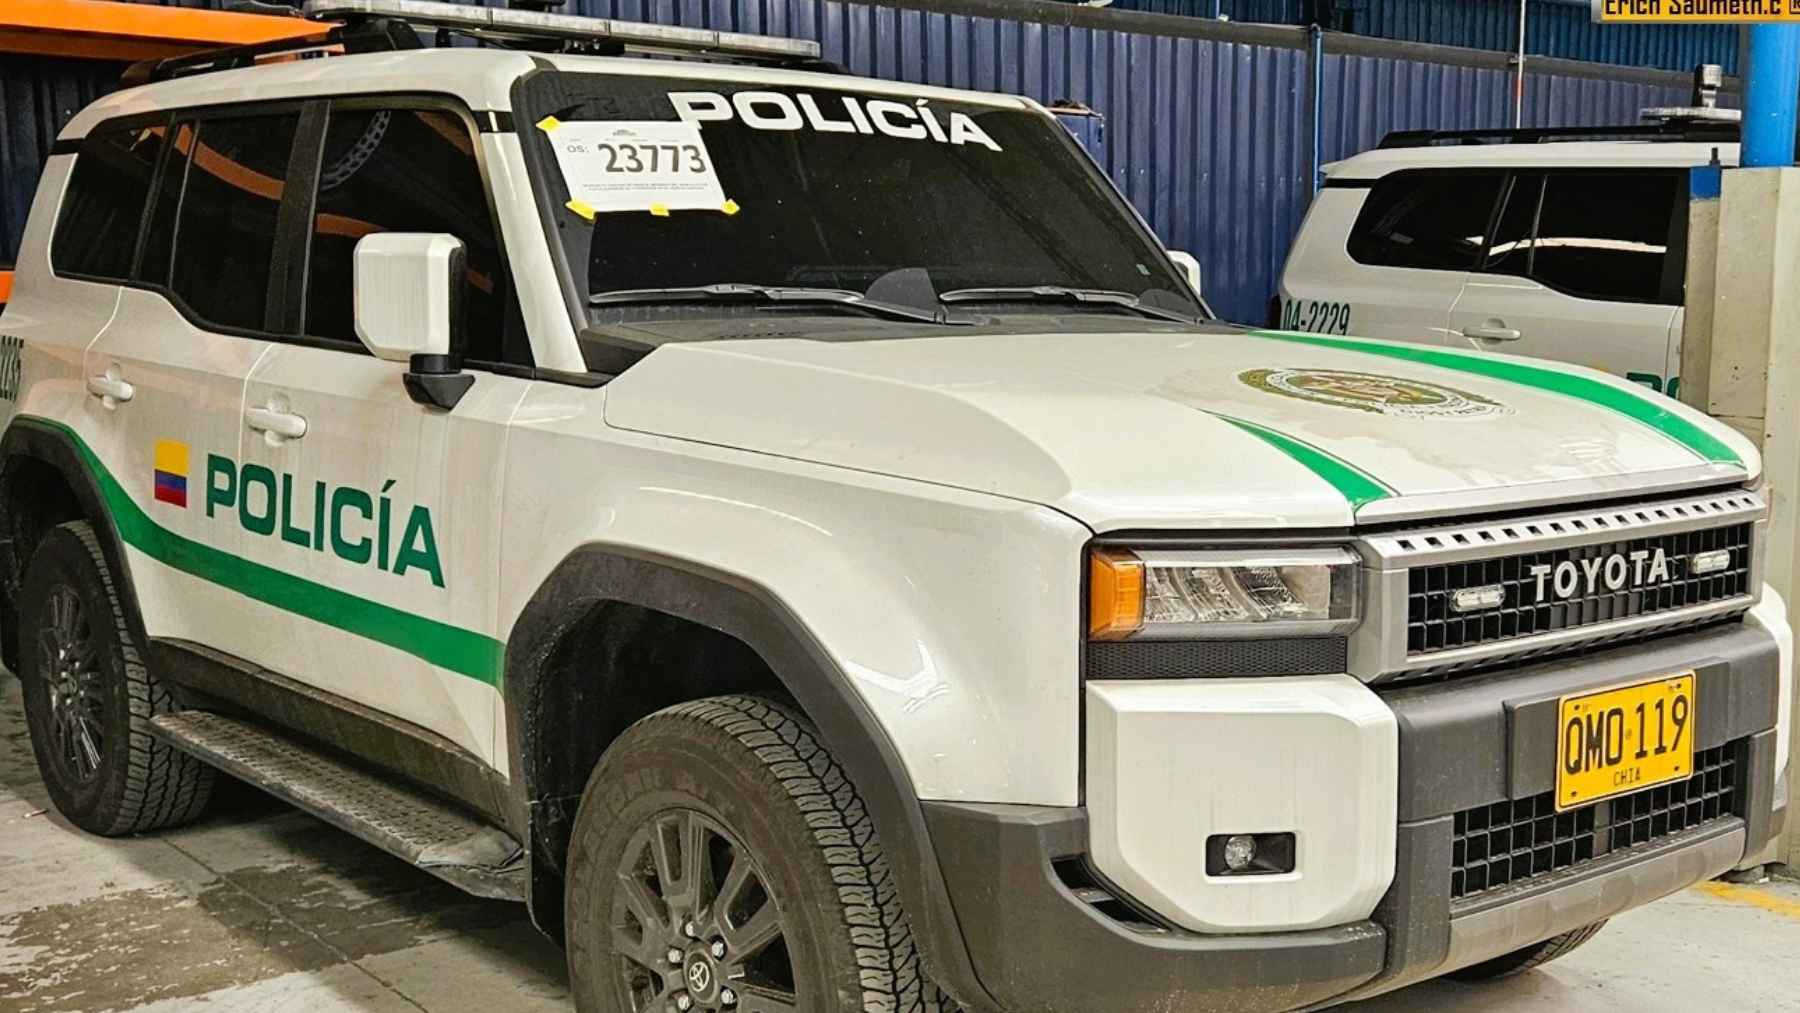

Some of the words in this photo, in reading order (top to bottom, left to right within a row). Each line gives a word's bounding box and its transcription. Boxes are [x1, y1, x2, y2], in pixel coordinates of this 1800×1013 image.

[667, 91, 1003, 152] POLICÍA
[598, 143, 707, 173] 23773
[206, 453, 446, 589] POLICÍA
[1530, 548, 1670, 602] TOYOTA
[1565, 707, 1625, 775] QMO
[1634, 694, 1690, 760] 119
[1613, 767, 1641, 787] CHIA
